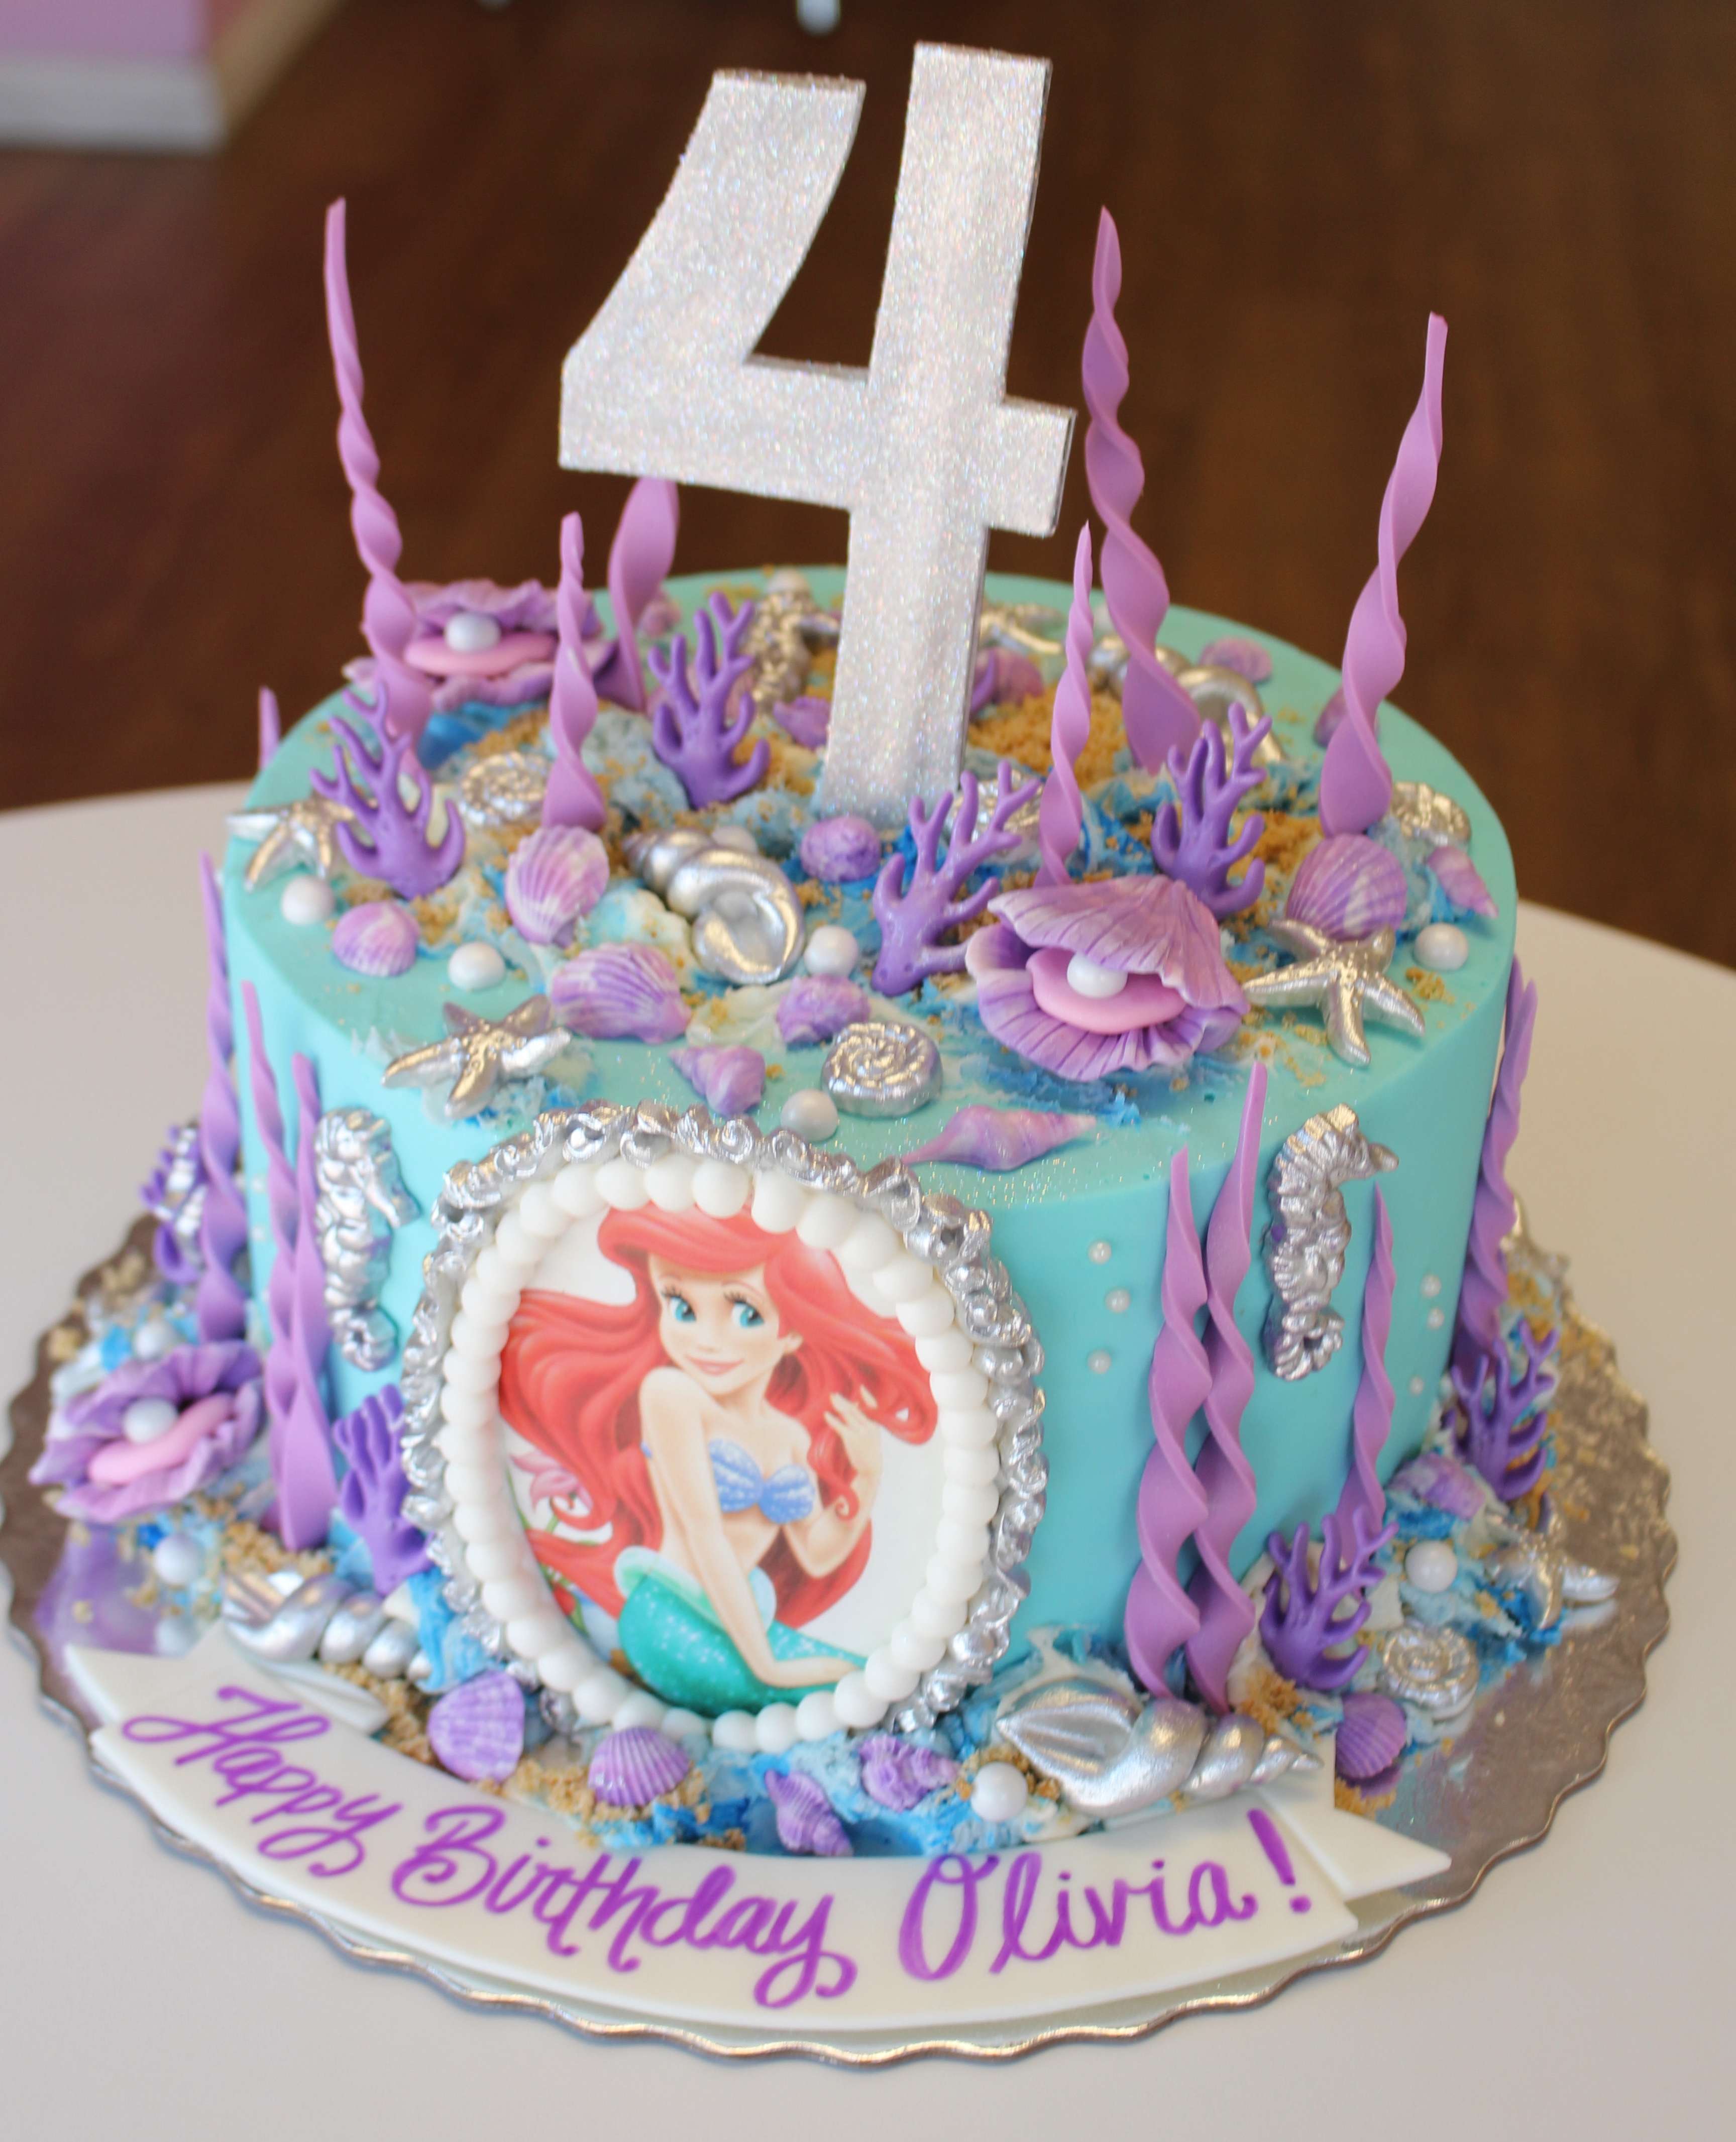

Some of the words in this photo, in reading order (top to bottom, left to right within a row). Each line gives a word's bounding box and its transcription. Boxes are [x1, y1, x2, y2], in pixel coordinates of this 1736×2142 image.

[559, 41, 1078, 824] 4
[122, 1685, 402, 1877] Happy
[391, 1804, 858, 2009] Birthday
[898, 1809, 1312, 1981] Olivia!
